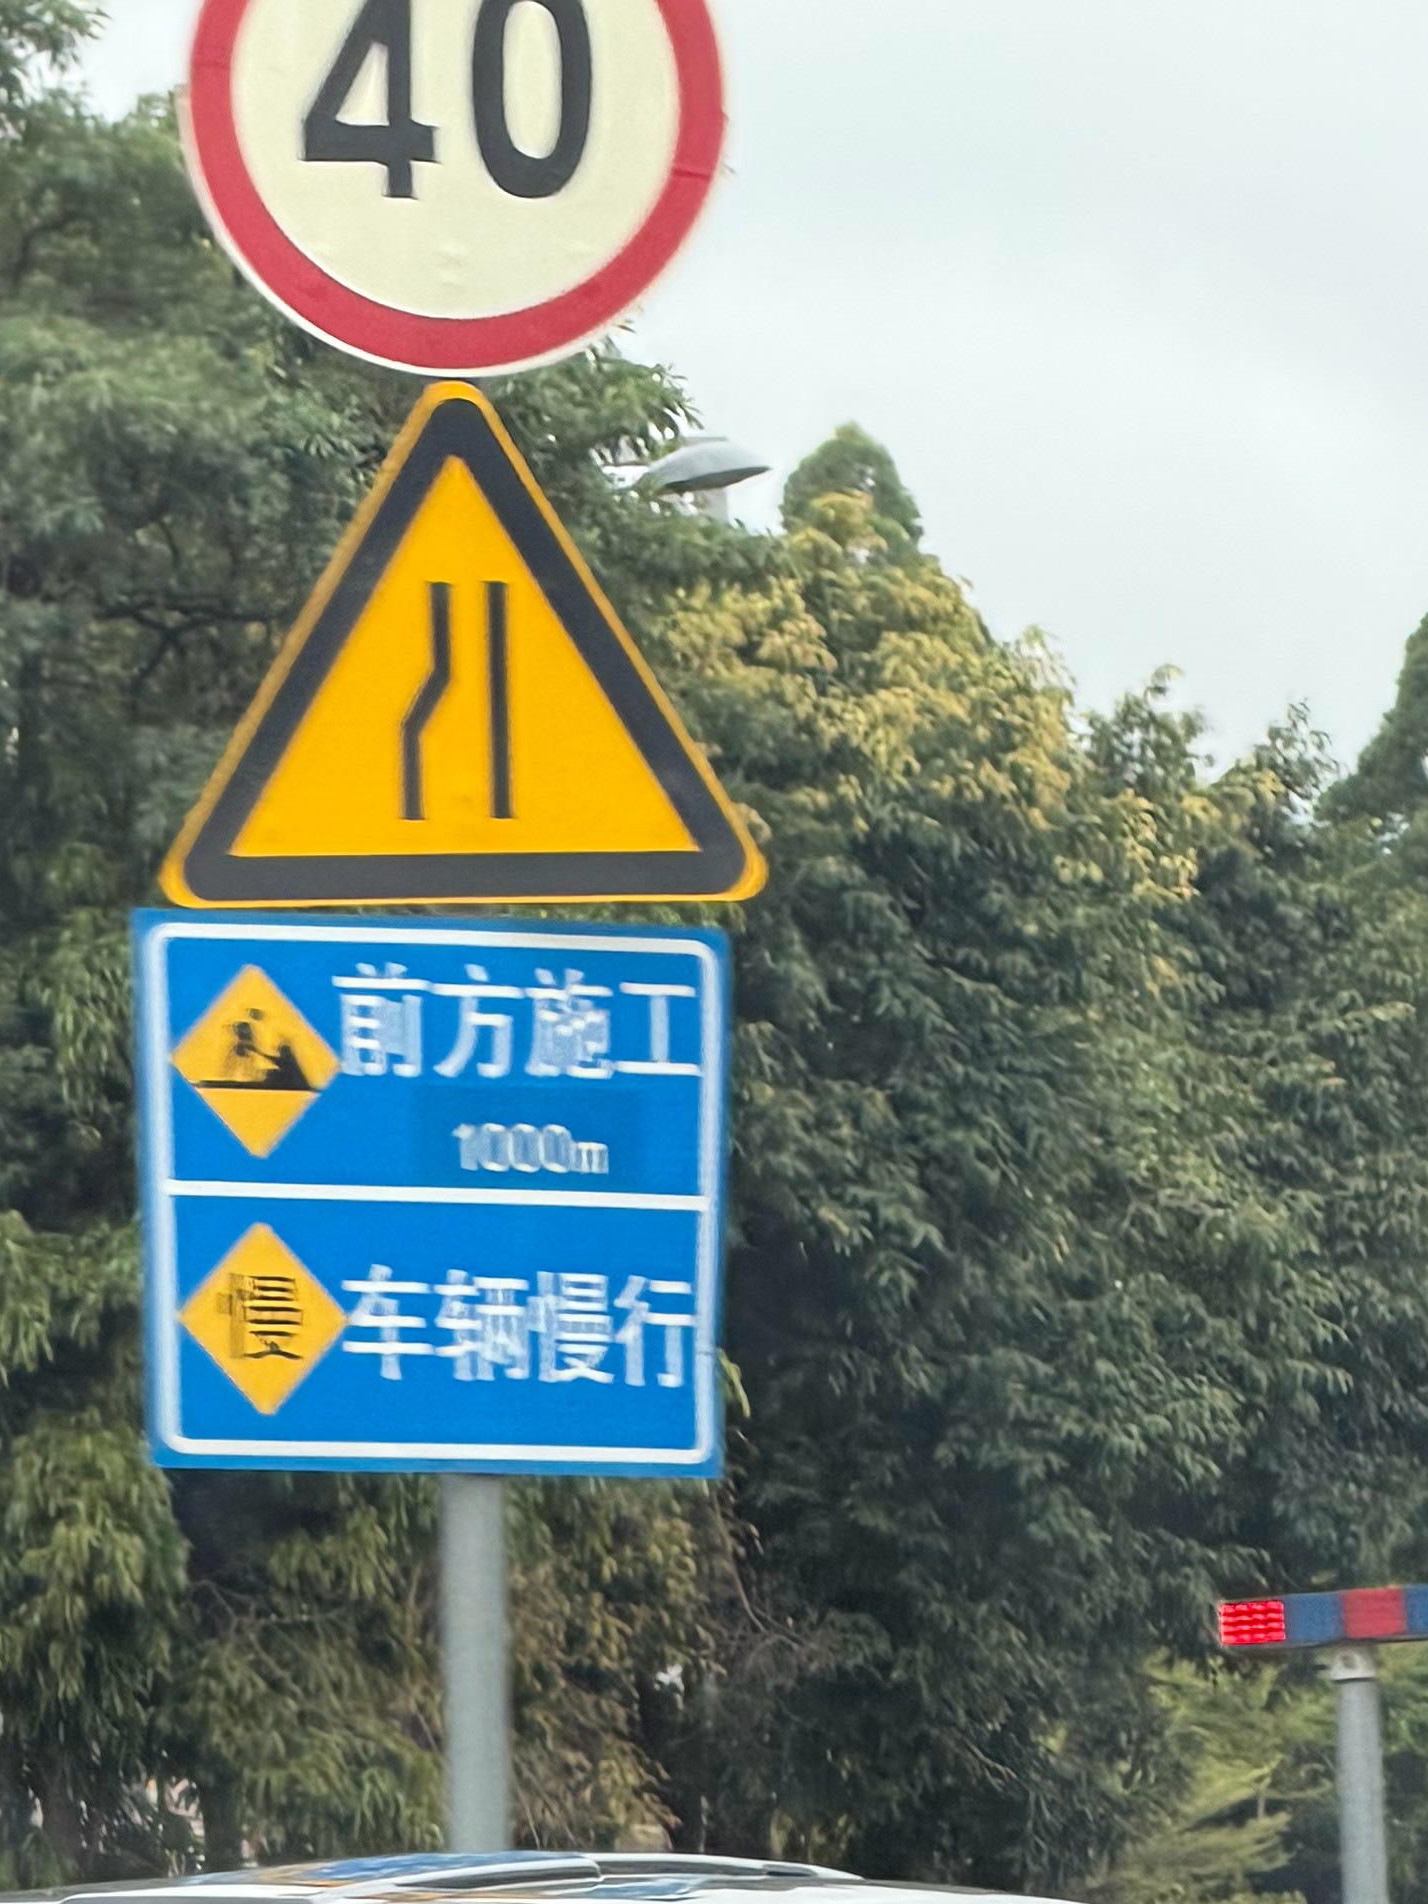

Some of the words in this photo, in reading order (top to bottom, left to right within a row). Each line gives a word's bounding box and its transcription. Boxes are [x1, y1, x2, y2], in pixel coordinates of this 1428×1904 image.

[302, 0, 593, 200] 40
[331, 961, 704, 1078] 前方施工
[452, 1123, 609, 1174] 1000m
[340, 1263, 694, 1388] 车辆慢行
